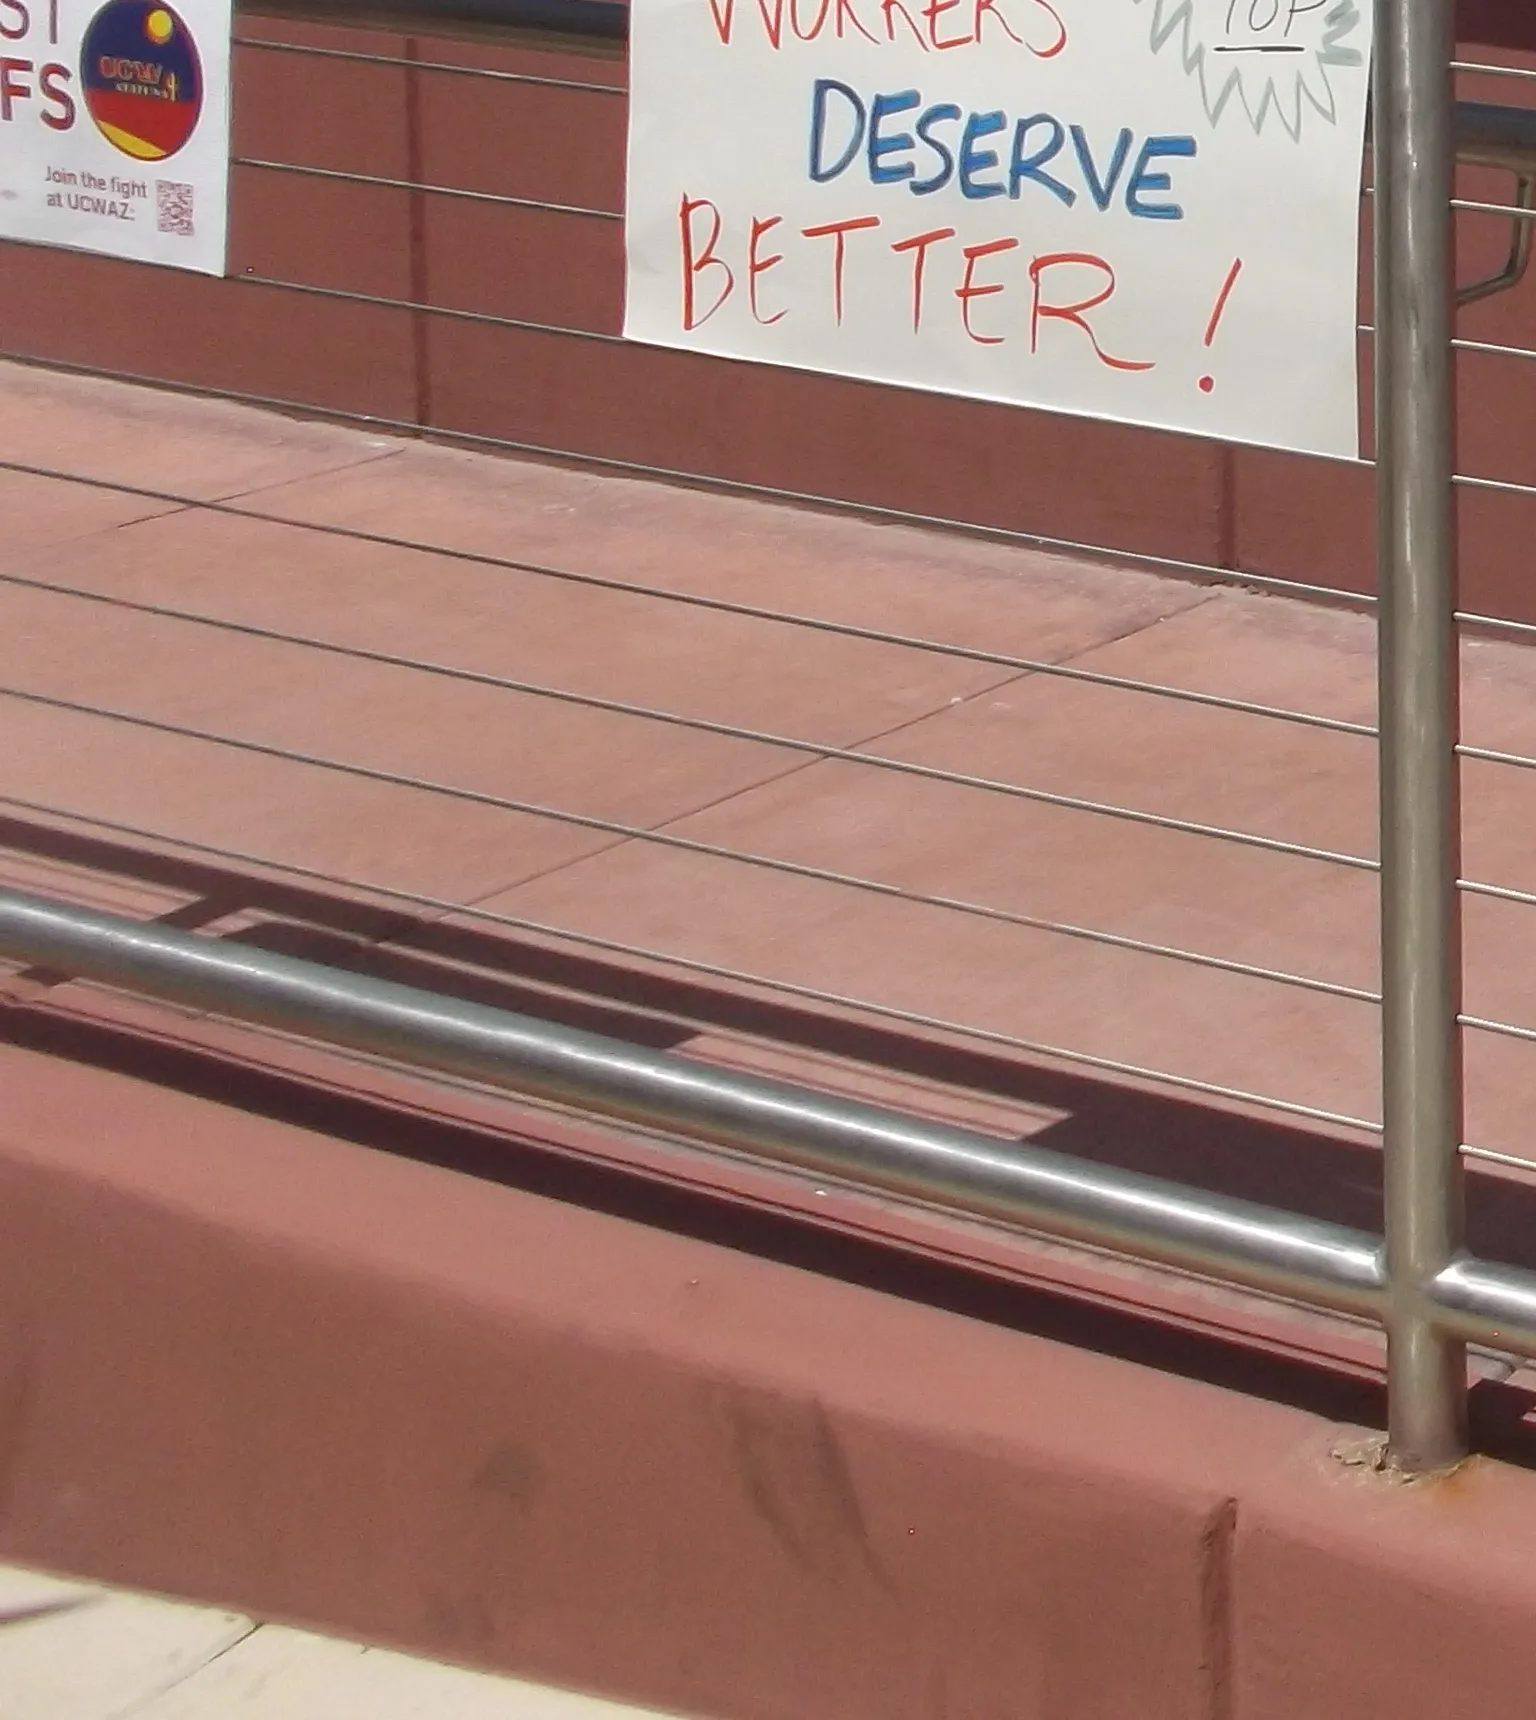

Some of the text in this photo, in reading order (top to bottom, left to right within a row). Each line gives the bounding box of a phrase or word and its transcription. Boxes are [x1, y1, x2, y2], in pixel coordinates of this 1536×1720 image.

[807, 78, 1197, 221] DESERVE
[45, 166, 148, 200] Join the fight
[46, 192, 62, 208] at
